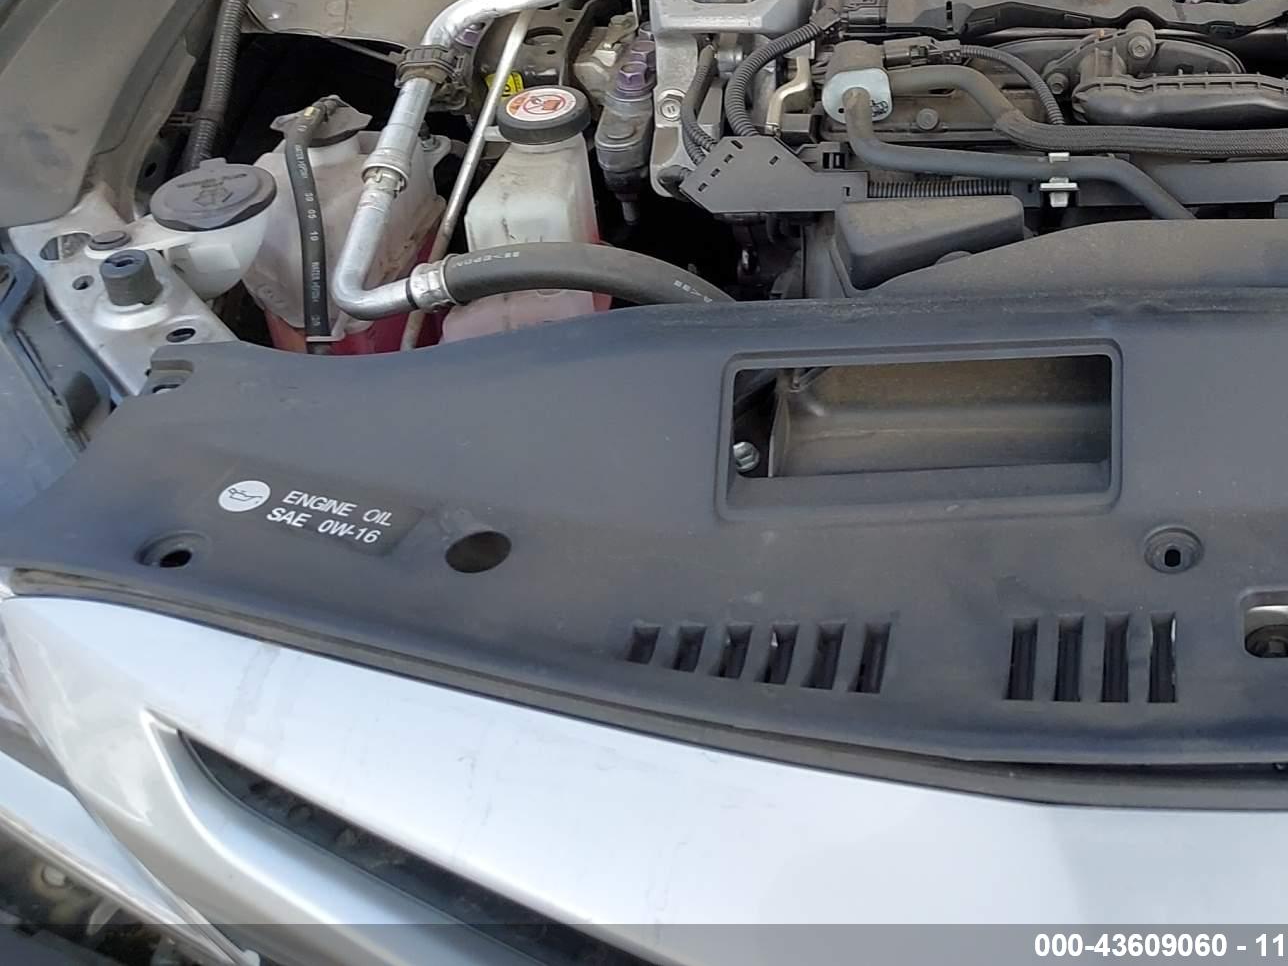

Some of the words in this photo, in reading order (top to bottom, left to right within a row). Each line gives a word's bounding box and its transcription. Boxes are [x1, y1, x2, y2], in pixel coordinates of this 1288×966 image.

[266, 507, 313, 528] SAE
[317, 519, 382, 544] 0W-16
[282, 490, 358, 517] ENGINE
[362, 508, 393, 526] OIL
